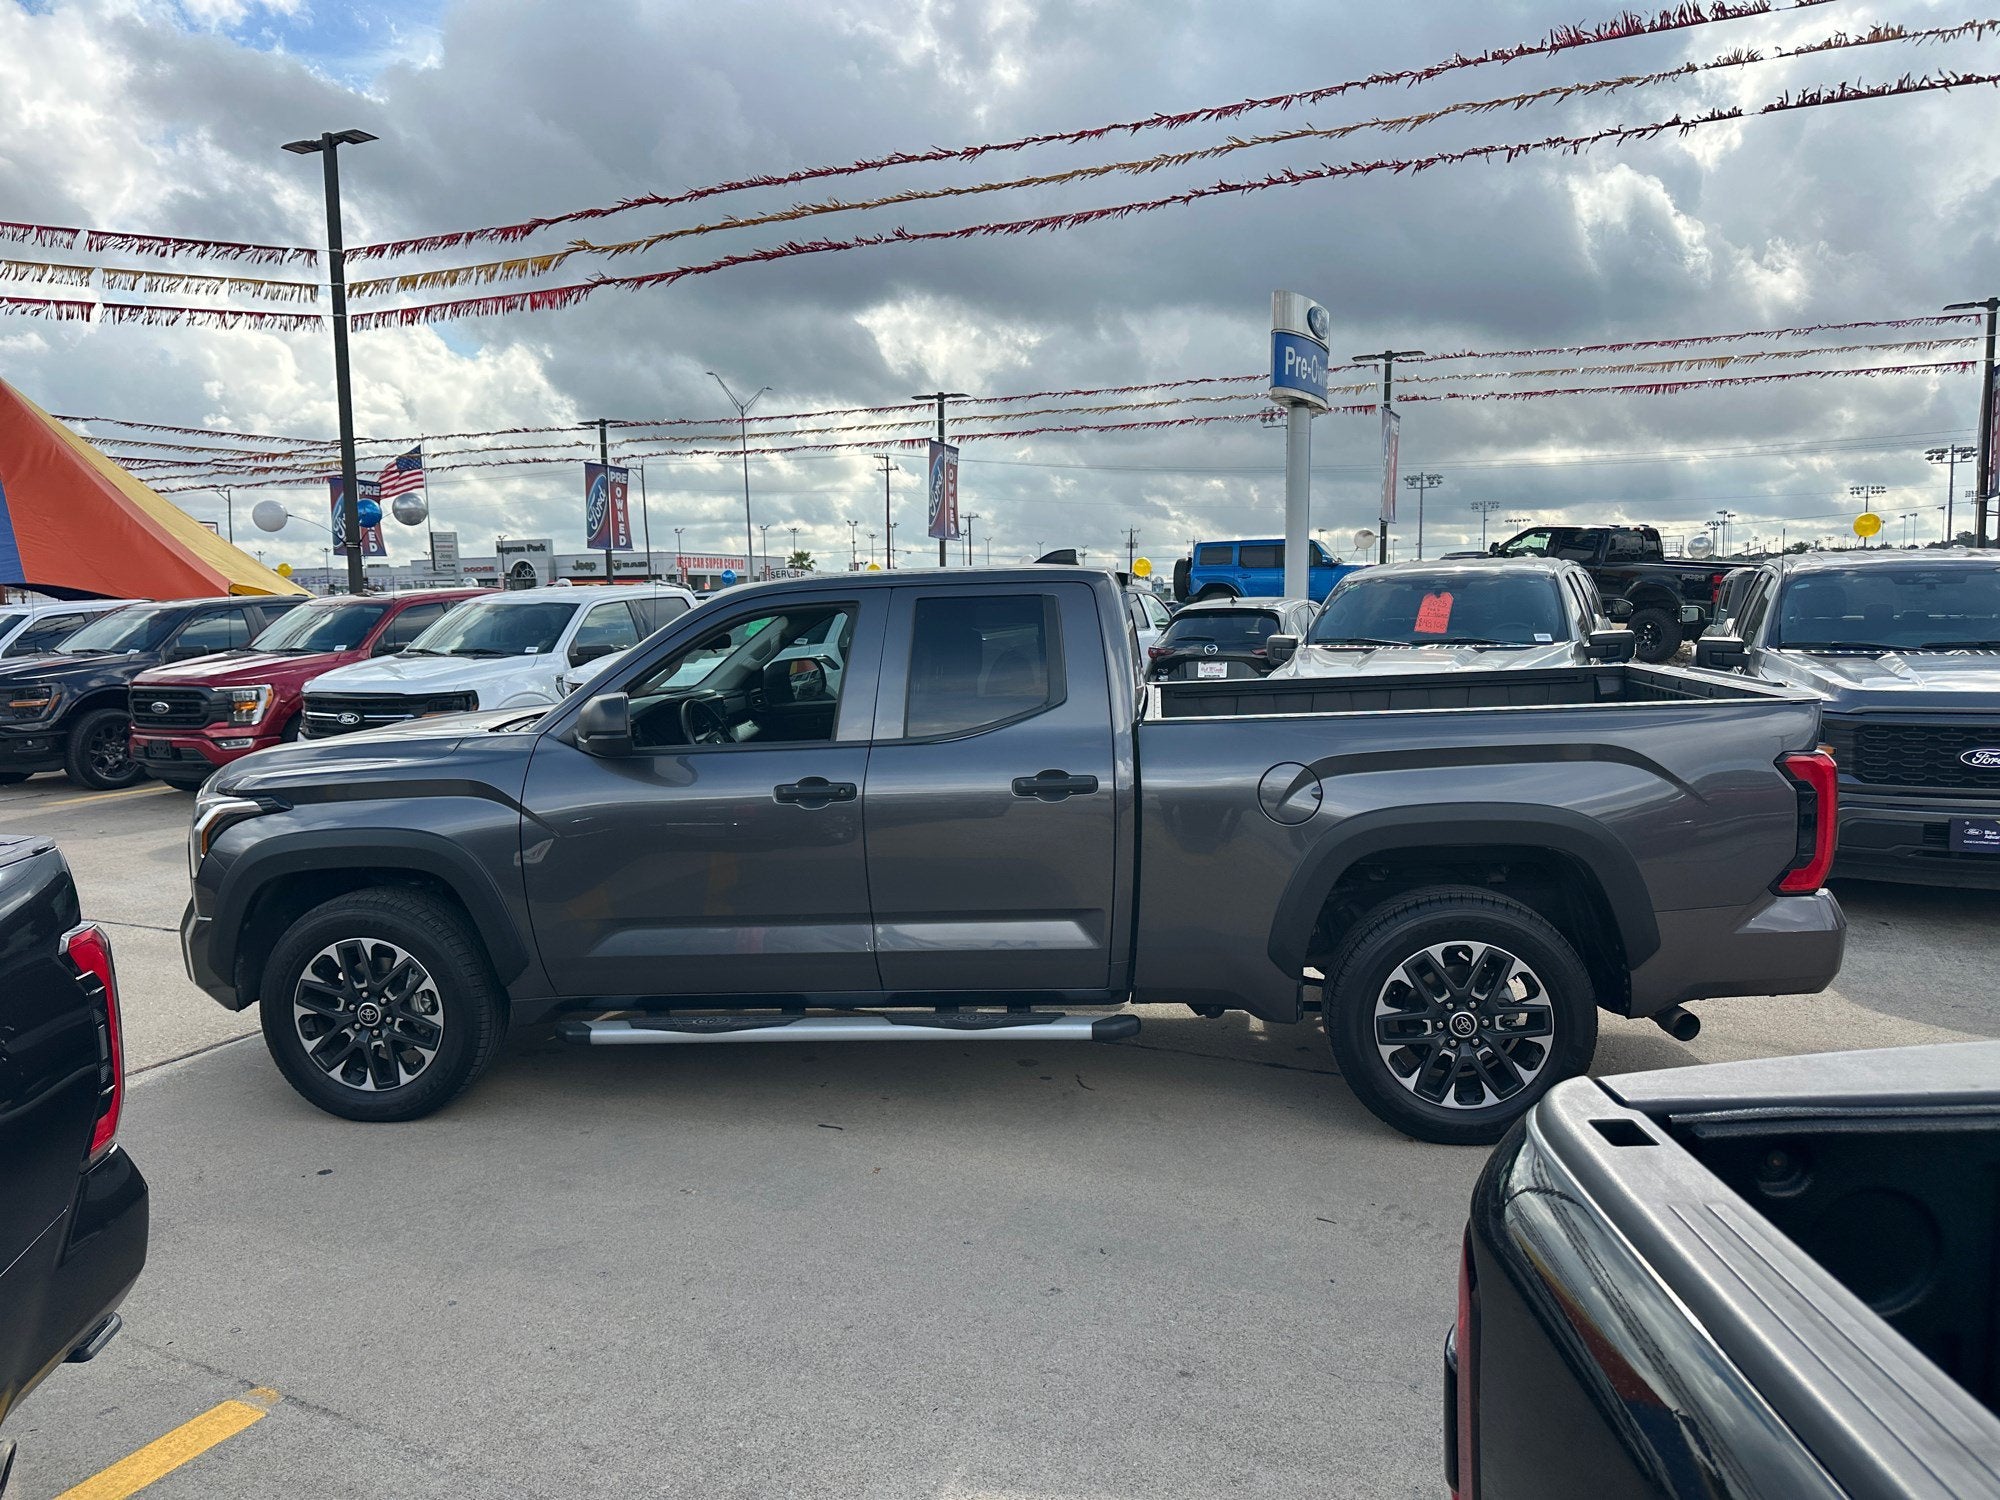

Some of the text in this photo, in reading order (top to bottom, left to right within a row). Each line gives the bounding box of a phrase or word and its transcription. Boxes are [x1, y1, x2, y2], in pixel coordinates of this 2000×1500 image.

[946, 451, 958, 465] PRE
[610, 471, 628, 485] PRE
[360, 484, 381, 496] PRE
[588, 485, 607, 530] Ford
[948, 469, 956, 535] OWNED
[615, 487, 627, 546] OWNED
[527, 543, 546, 552] Park
[572, 560, 597, 572] Jeep
[693, 557, 705, 569] CAR
[705, 558, 723, 569] SUPER
[724, 558, 745, 570] CENTER
